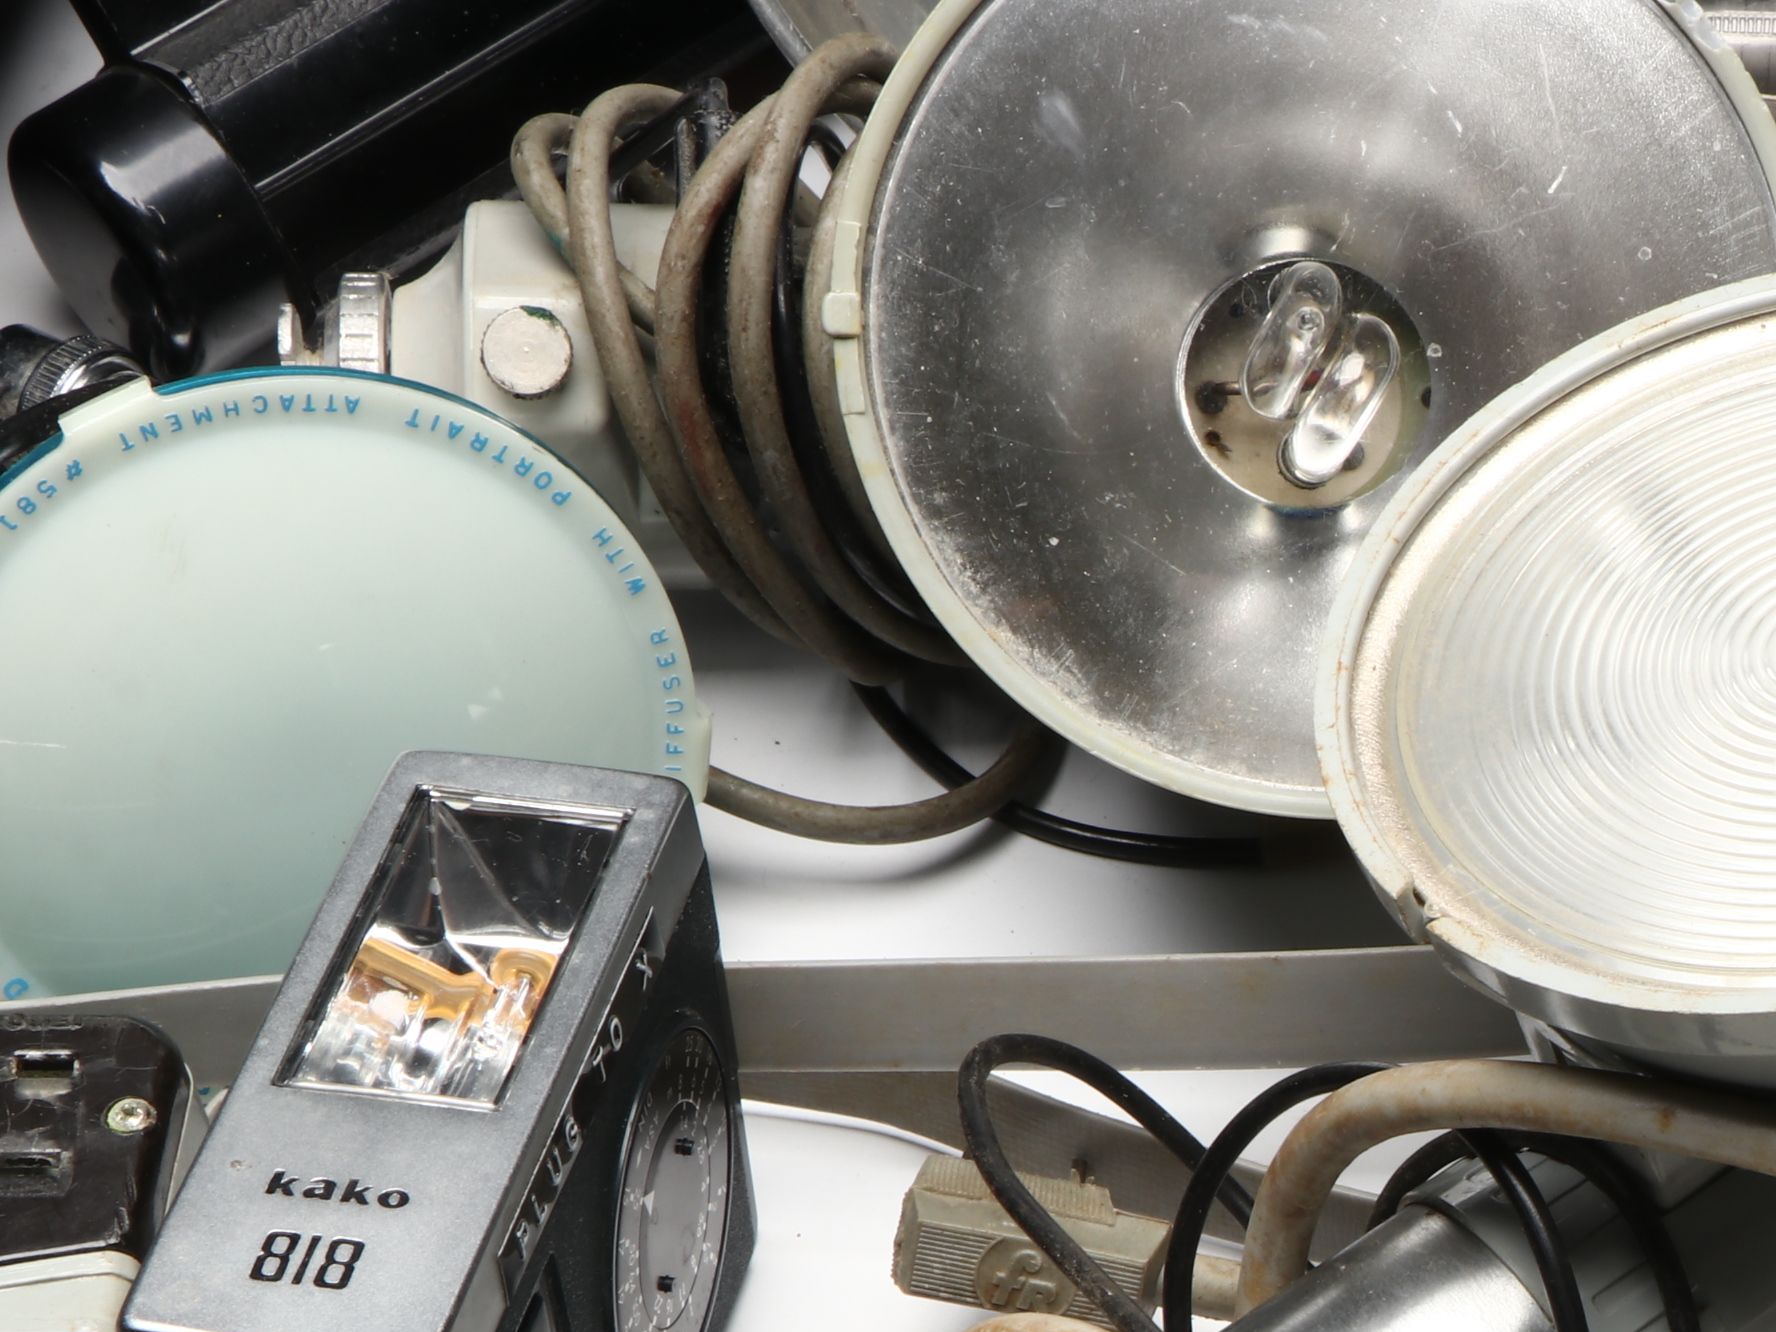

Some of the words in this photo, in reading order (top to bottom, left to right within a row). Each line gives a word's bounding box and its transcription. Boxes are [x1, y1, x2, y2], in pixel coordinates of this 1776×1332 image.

[118, 394, 362, 452] ATTACHMENT
[404, 407, 573, 507] PORTRAIT
[592, 527, 647, 596] WITH
[649, 628, 685, 772] IFFUSER
[264, 1169, 412, 1210] kako
[248, 1230, 367, 1291] 818
